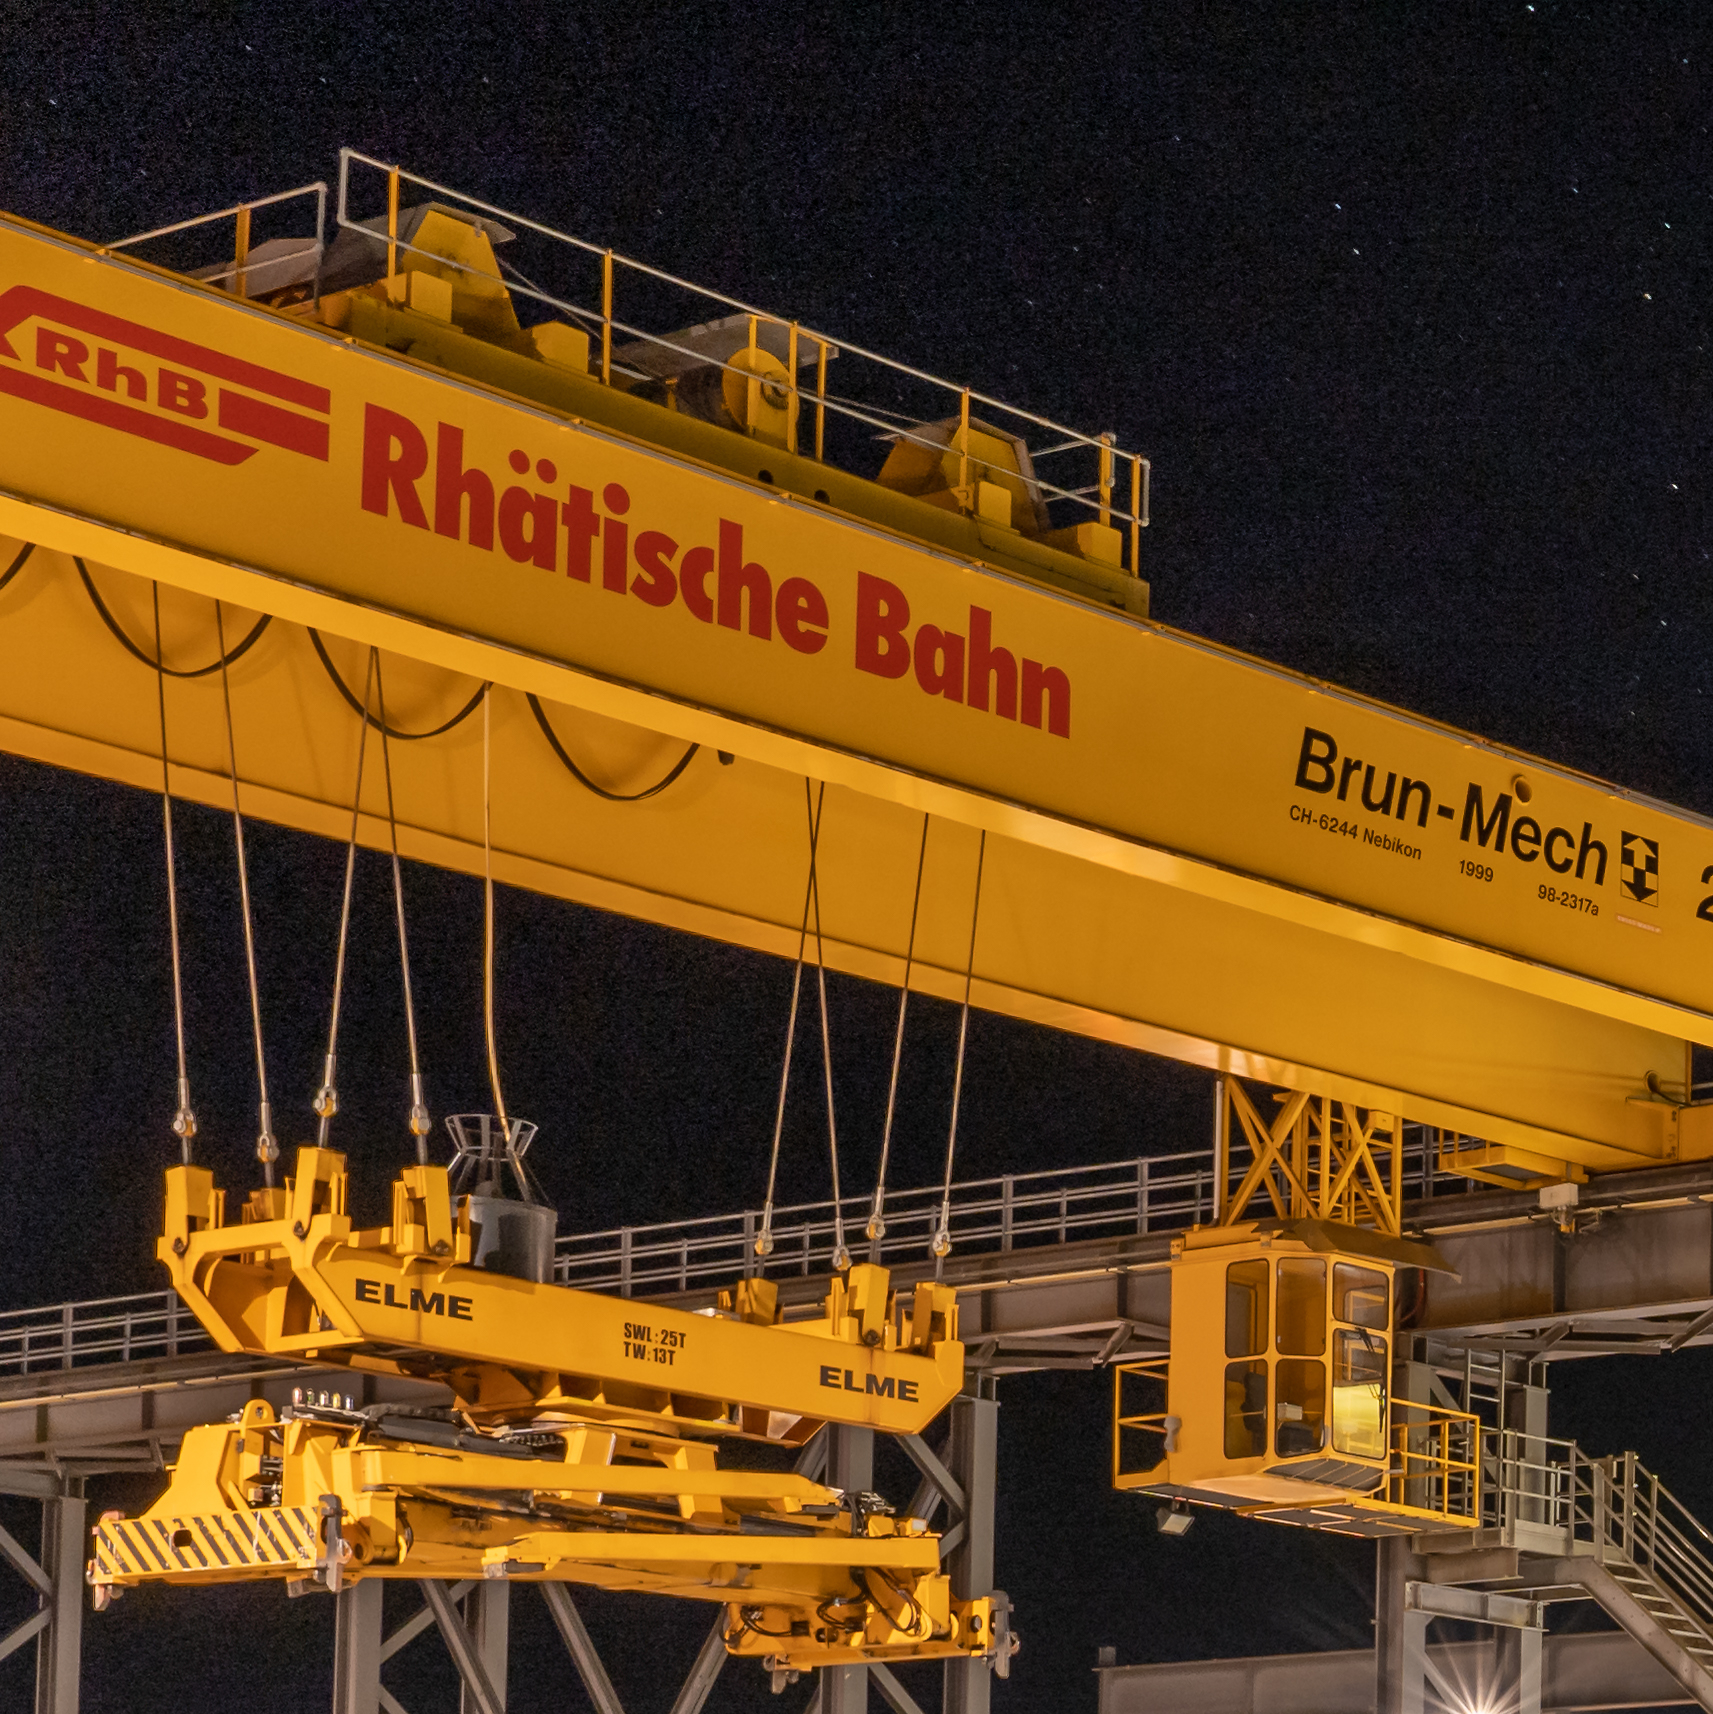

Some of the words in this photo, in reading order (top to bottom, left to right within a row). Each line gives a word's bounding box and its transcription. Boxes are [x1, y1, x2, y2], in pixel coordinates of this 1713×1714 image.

[35, 326, 209, 421] RhB
[361, 402, 830, 655] Rhätische
[854, 570, 1071, 740] Bahn
[1295, 726, 1609, 887] Brun-Mech
[1289, 804, 1358, 840] CH-6244
[1363, 827, 1422, 861] Nebikon
[1459, 859, 1494, 883] 1999
[1538, 884, 1600, 916] 98-2317a
[355, 1278, 473, 1322] ELME
[820, 1364, 919, 1404] ELME
